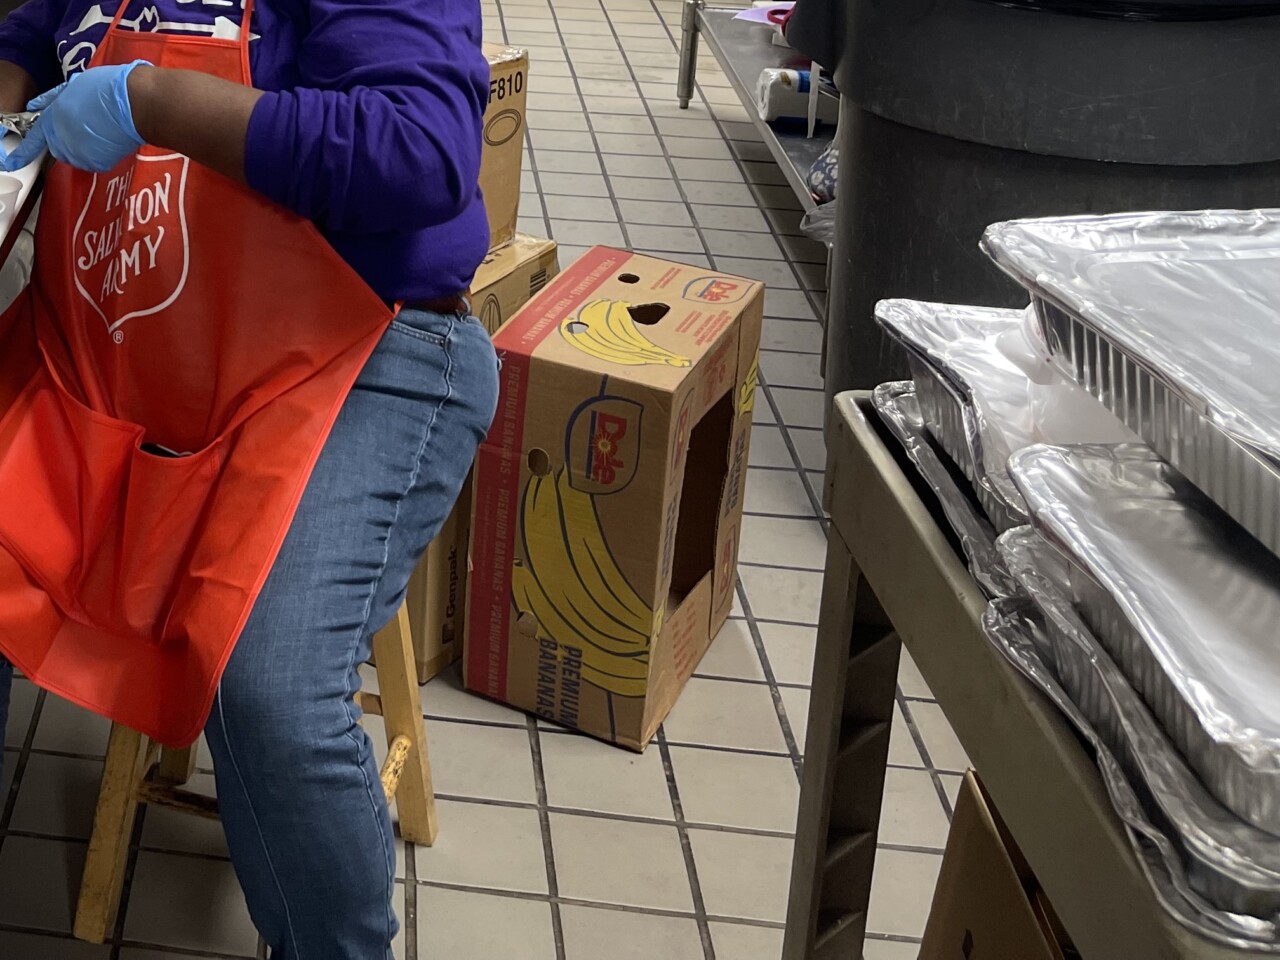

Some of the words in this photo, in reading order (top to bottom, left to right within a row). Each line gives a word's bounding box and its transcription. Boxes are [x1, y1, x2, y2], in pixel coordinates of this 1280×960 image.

[488, 71, 523, 103] F810
[100, 225, 165, 303] ARMY
[503, 365, 520, 420] PREMIUM
[499, 421, 515, 475] BANANAS
[592, 411, 627, 485] Dole
[495, 488, 511, 539] PREMIUM
[446, 546, 458, 618] Genpak
[492, 540, 507, 591] BANANAS
[488, 604, 503, 653] PREMIUM
[536, 638, 558, 720] BANANAS
[559, 643, 583, 727] PREMIUM
